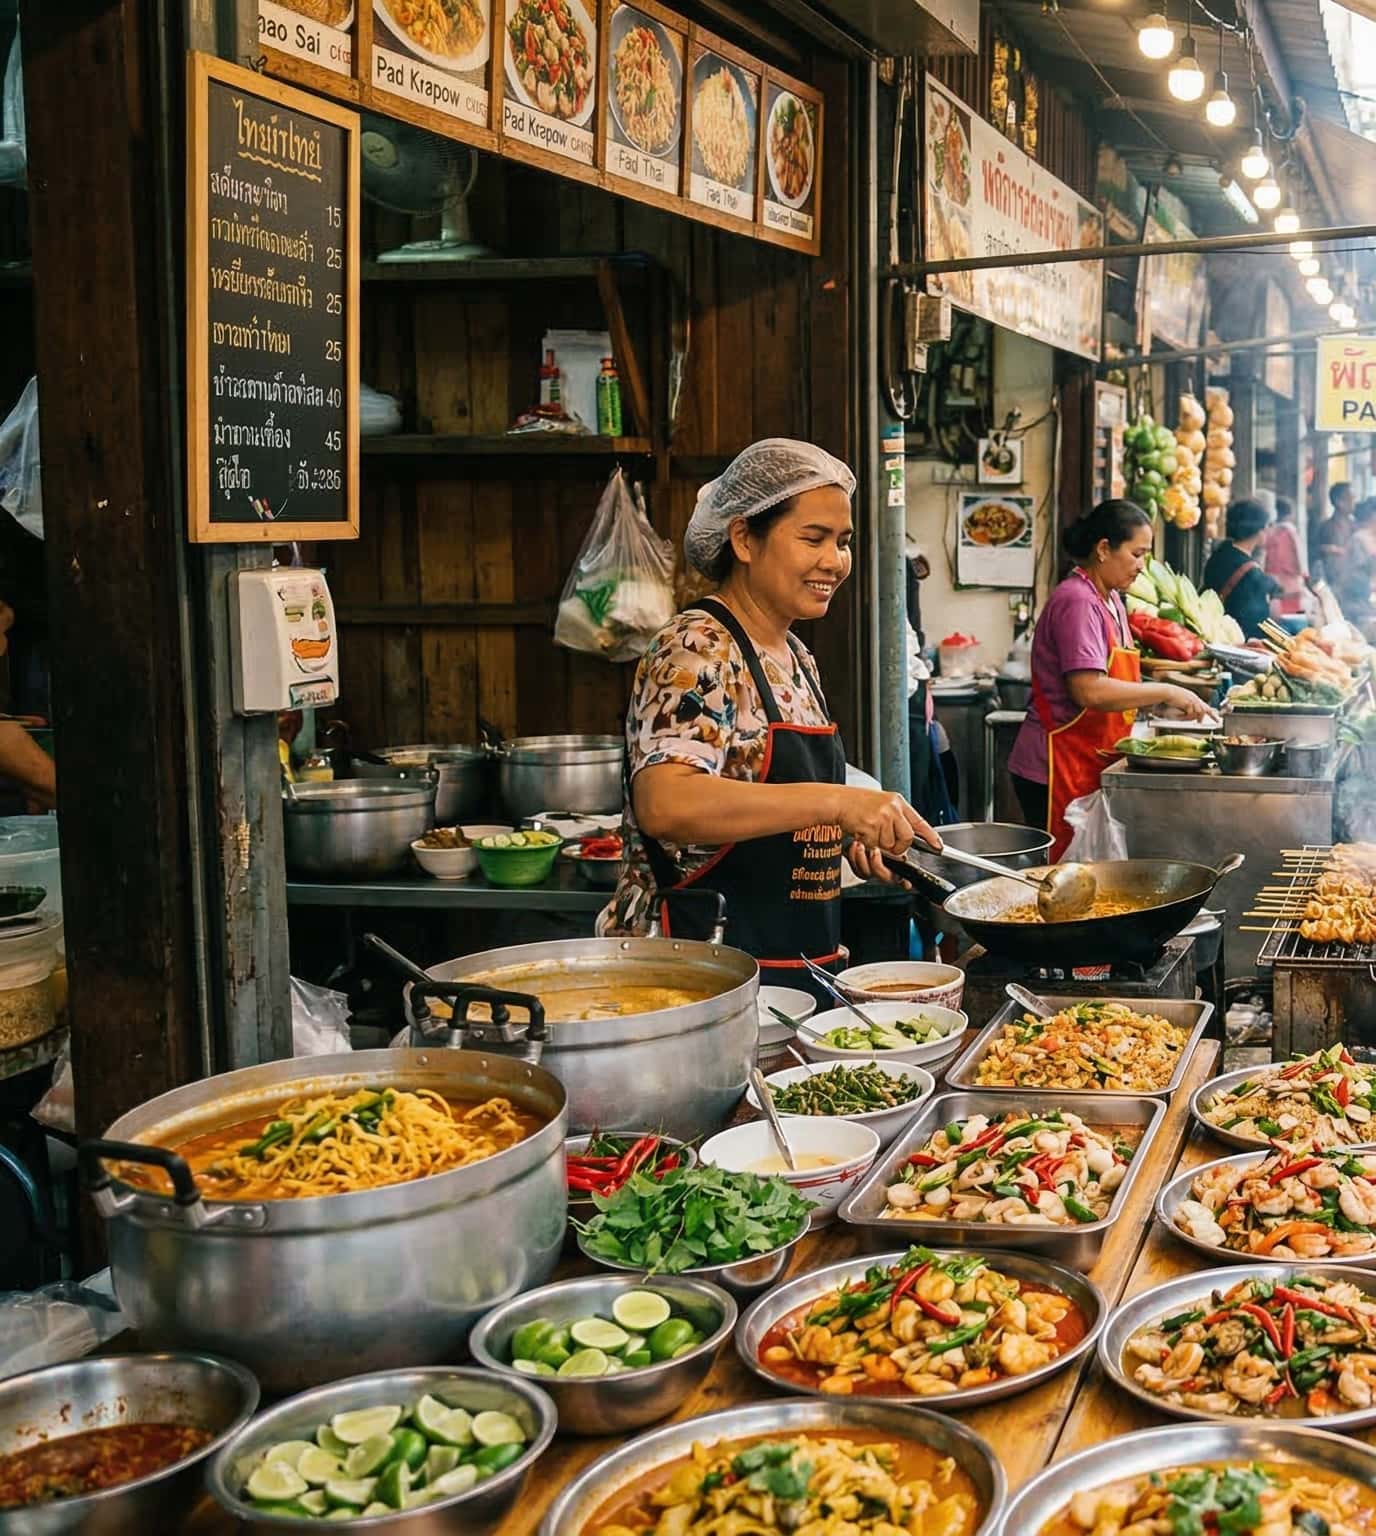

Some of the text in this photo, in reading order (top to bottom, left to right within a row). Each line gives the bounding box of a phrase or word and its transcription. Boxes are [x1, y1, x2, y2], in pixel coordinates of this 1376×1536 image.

[295, 24, 321, 56] Sai
[376, 56, 404, 86] Pad
[410, 69, 461, 108] Krapow
[504, 106, 525, 132] Pad
[325, 205, 342, 228] 15
[326, 246, 342, 269] 25
[326, 292, 342, 315] 25
[325, 340, 342, 361] 25
[326, 386, 341, 408] 40
[324, 430, 341, 451] 45
